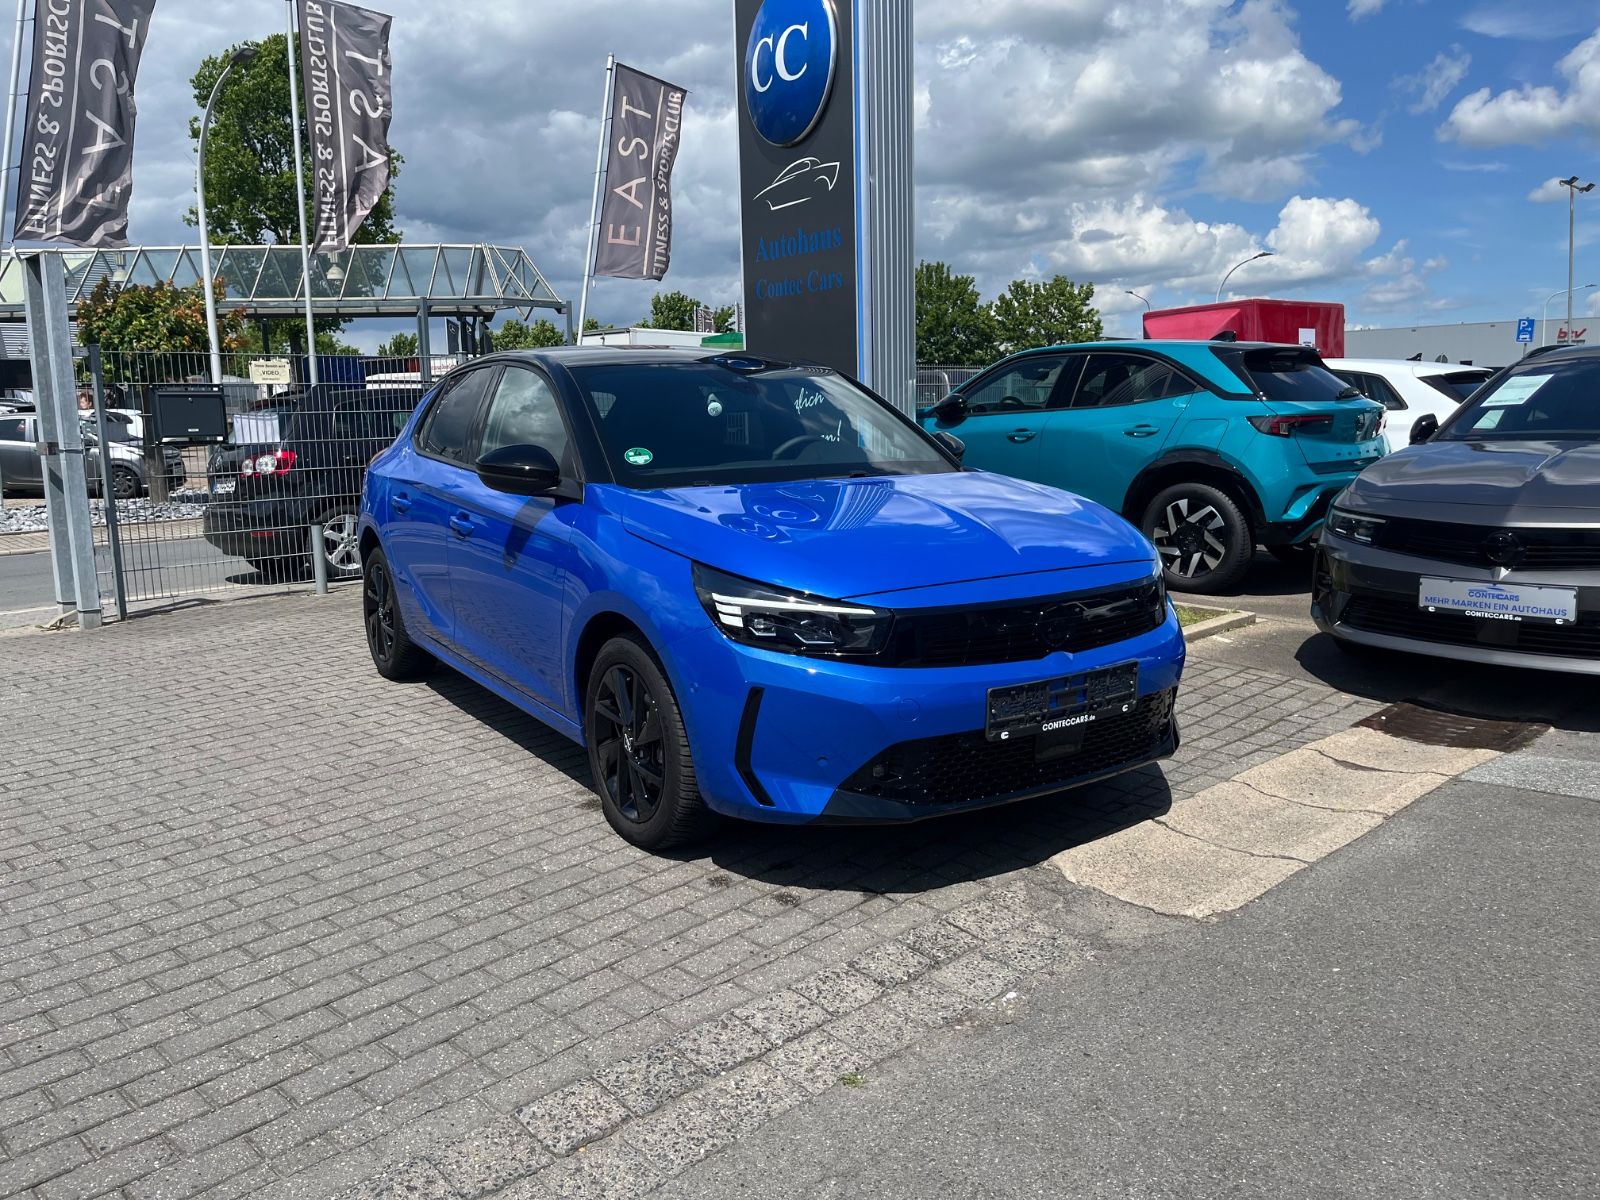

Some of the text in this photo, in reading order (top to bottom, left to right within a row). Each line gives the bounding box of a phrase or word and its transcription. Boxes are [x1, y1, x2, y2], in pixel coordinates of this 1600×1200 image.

[752, 22, 808, 93] CC
[608, 96, 652, 246] EAST
[653, 91, 683, 277] FITNESS & SPORTSCLUB
[756, 227, 843, 263] Autohaus
[755, 270, 843, 300] Contec Cars
[1520, 320, 1529, 330] P
[1557, 327, 1587, 340] bv
[1424, 596, 1567, 617] MEHR MARKEN EIN AUTOHAUS
[1468, 590, 1520, 602] CONTECCARS
[1465, 610, 1522, 622] CONTECCARS.de
[1042, 713, 1096, 732] CONTECCARS.de
